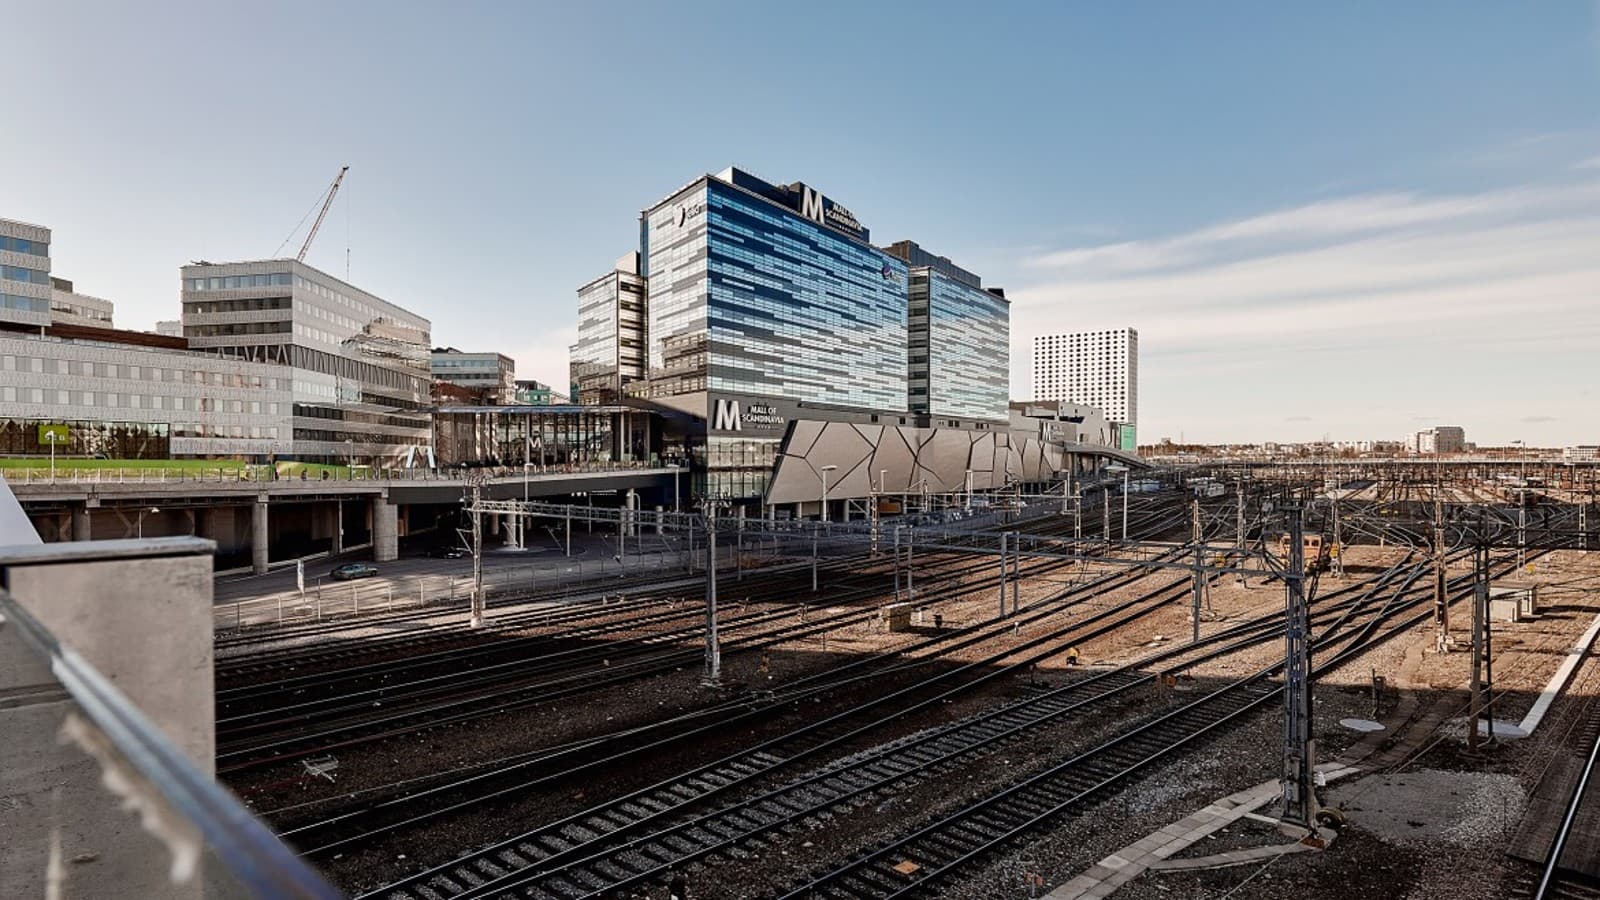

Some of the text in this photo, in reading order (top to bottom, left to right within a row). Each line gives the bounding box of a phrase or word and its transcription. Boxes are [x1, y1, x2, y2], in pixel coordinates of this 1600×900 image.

[801, 185, 825, 224] M
[716, 399, 742, 431] M
[741, 414, 785, 424] SCANDINAVIA
[750, 405, 777, 415] MALL OF
